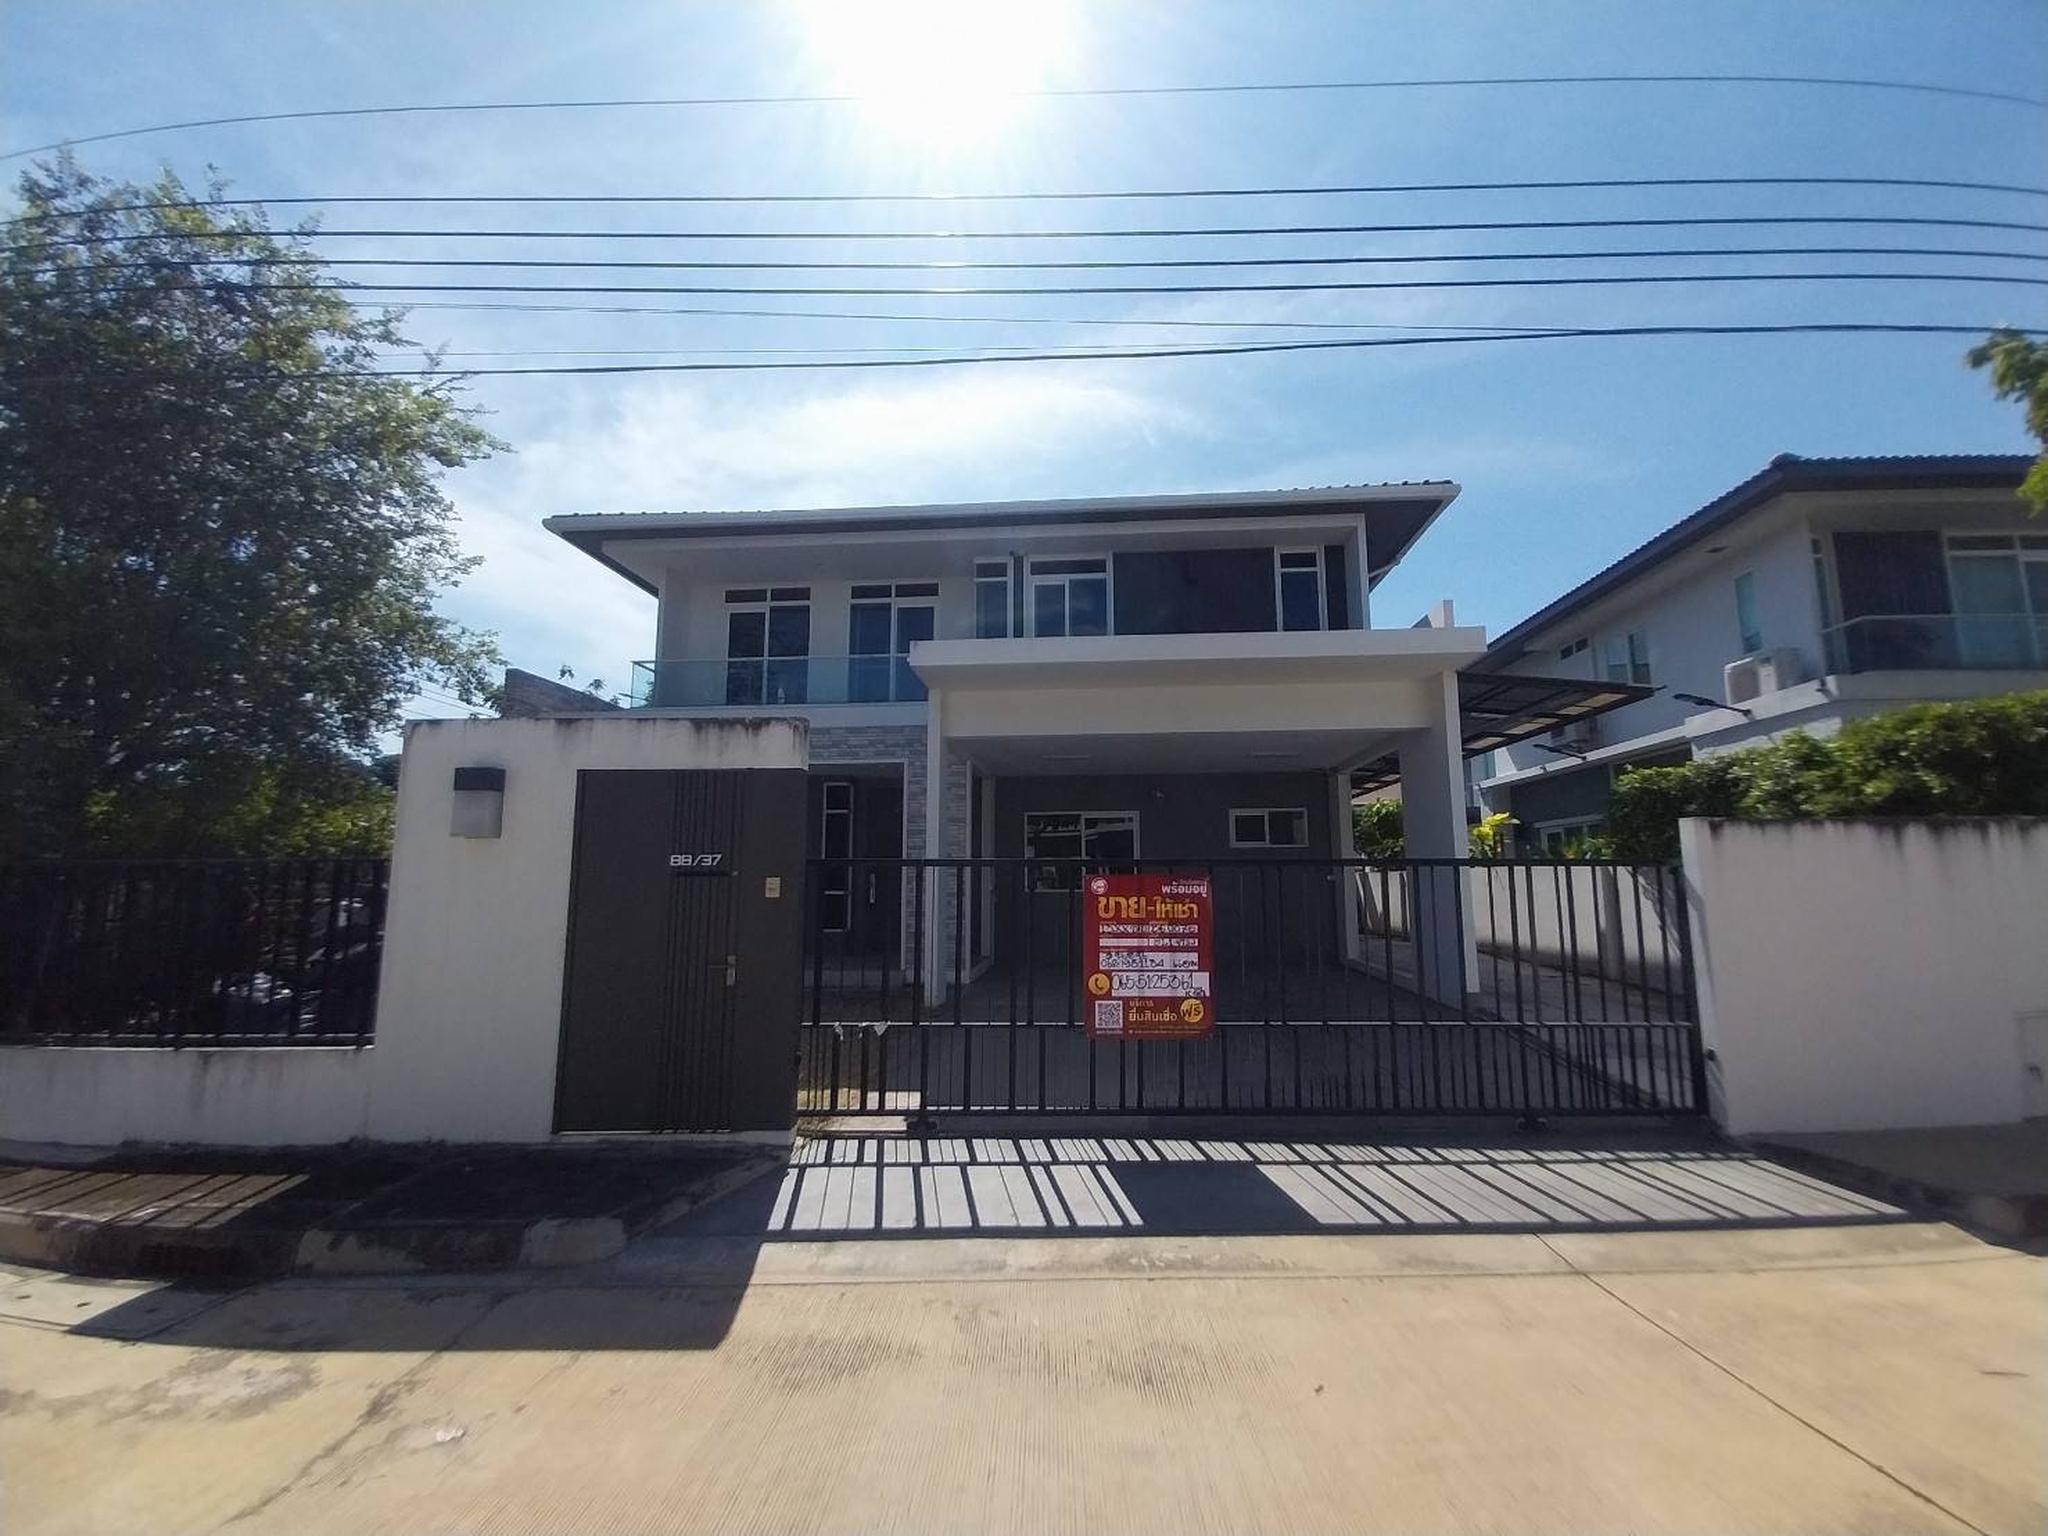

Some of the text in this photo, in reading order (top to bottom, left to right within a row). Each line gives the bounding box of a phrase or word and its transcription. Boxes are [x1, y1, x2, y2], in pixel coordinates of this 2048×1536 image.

[670, 854, 722, 866] 88/37
[1161, 880, 1208, 898] พร้อมอยู่
[1181, 1003, 1202, 1018] ฟรี
